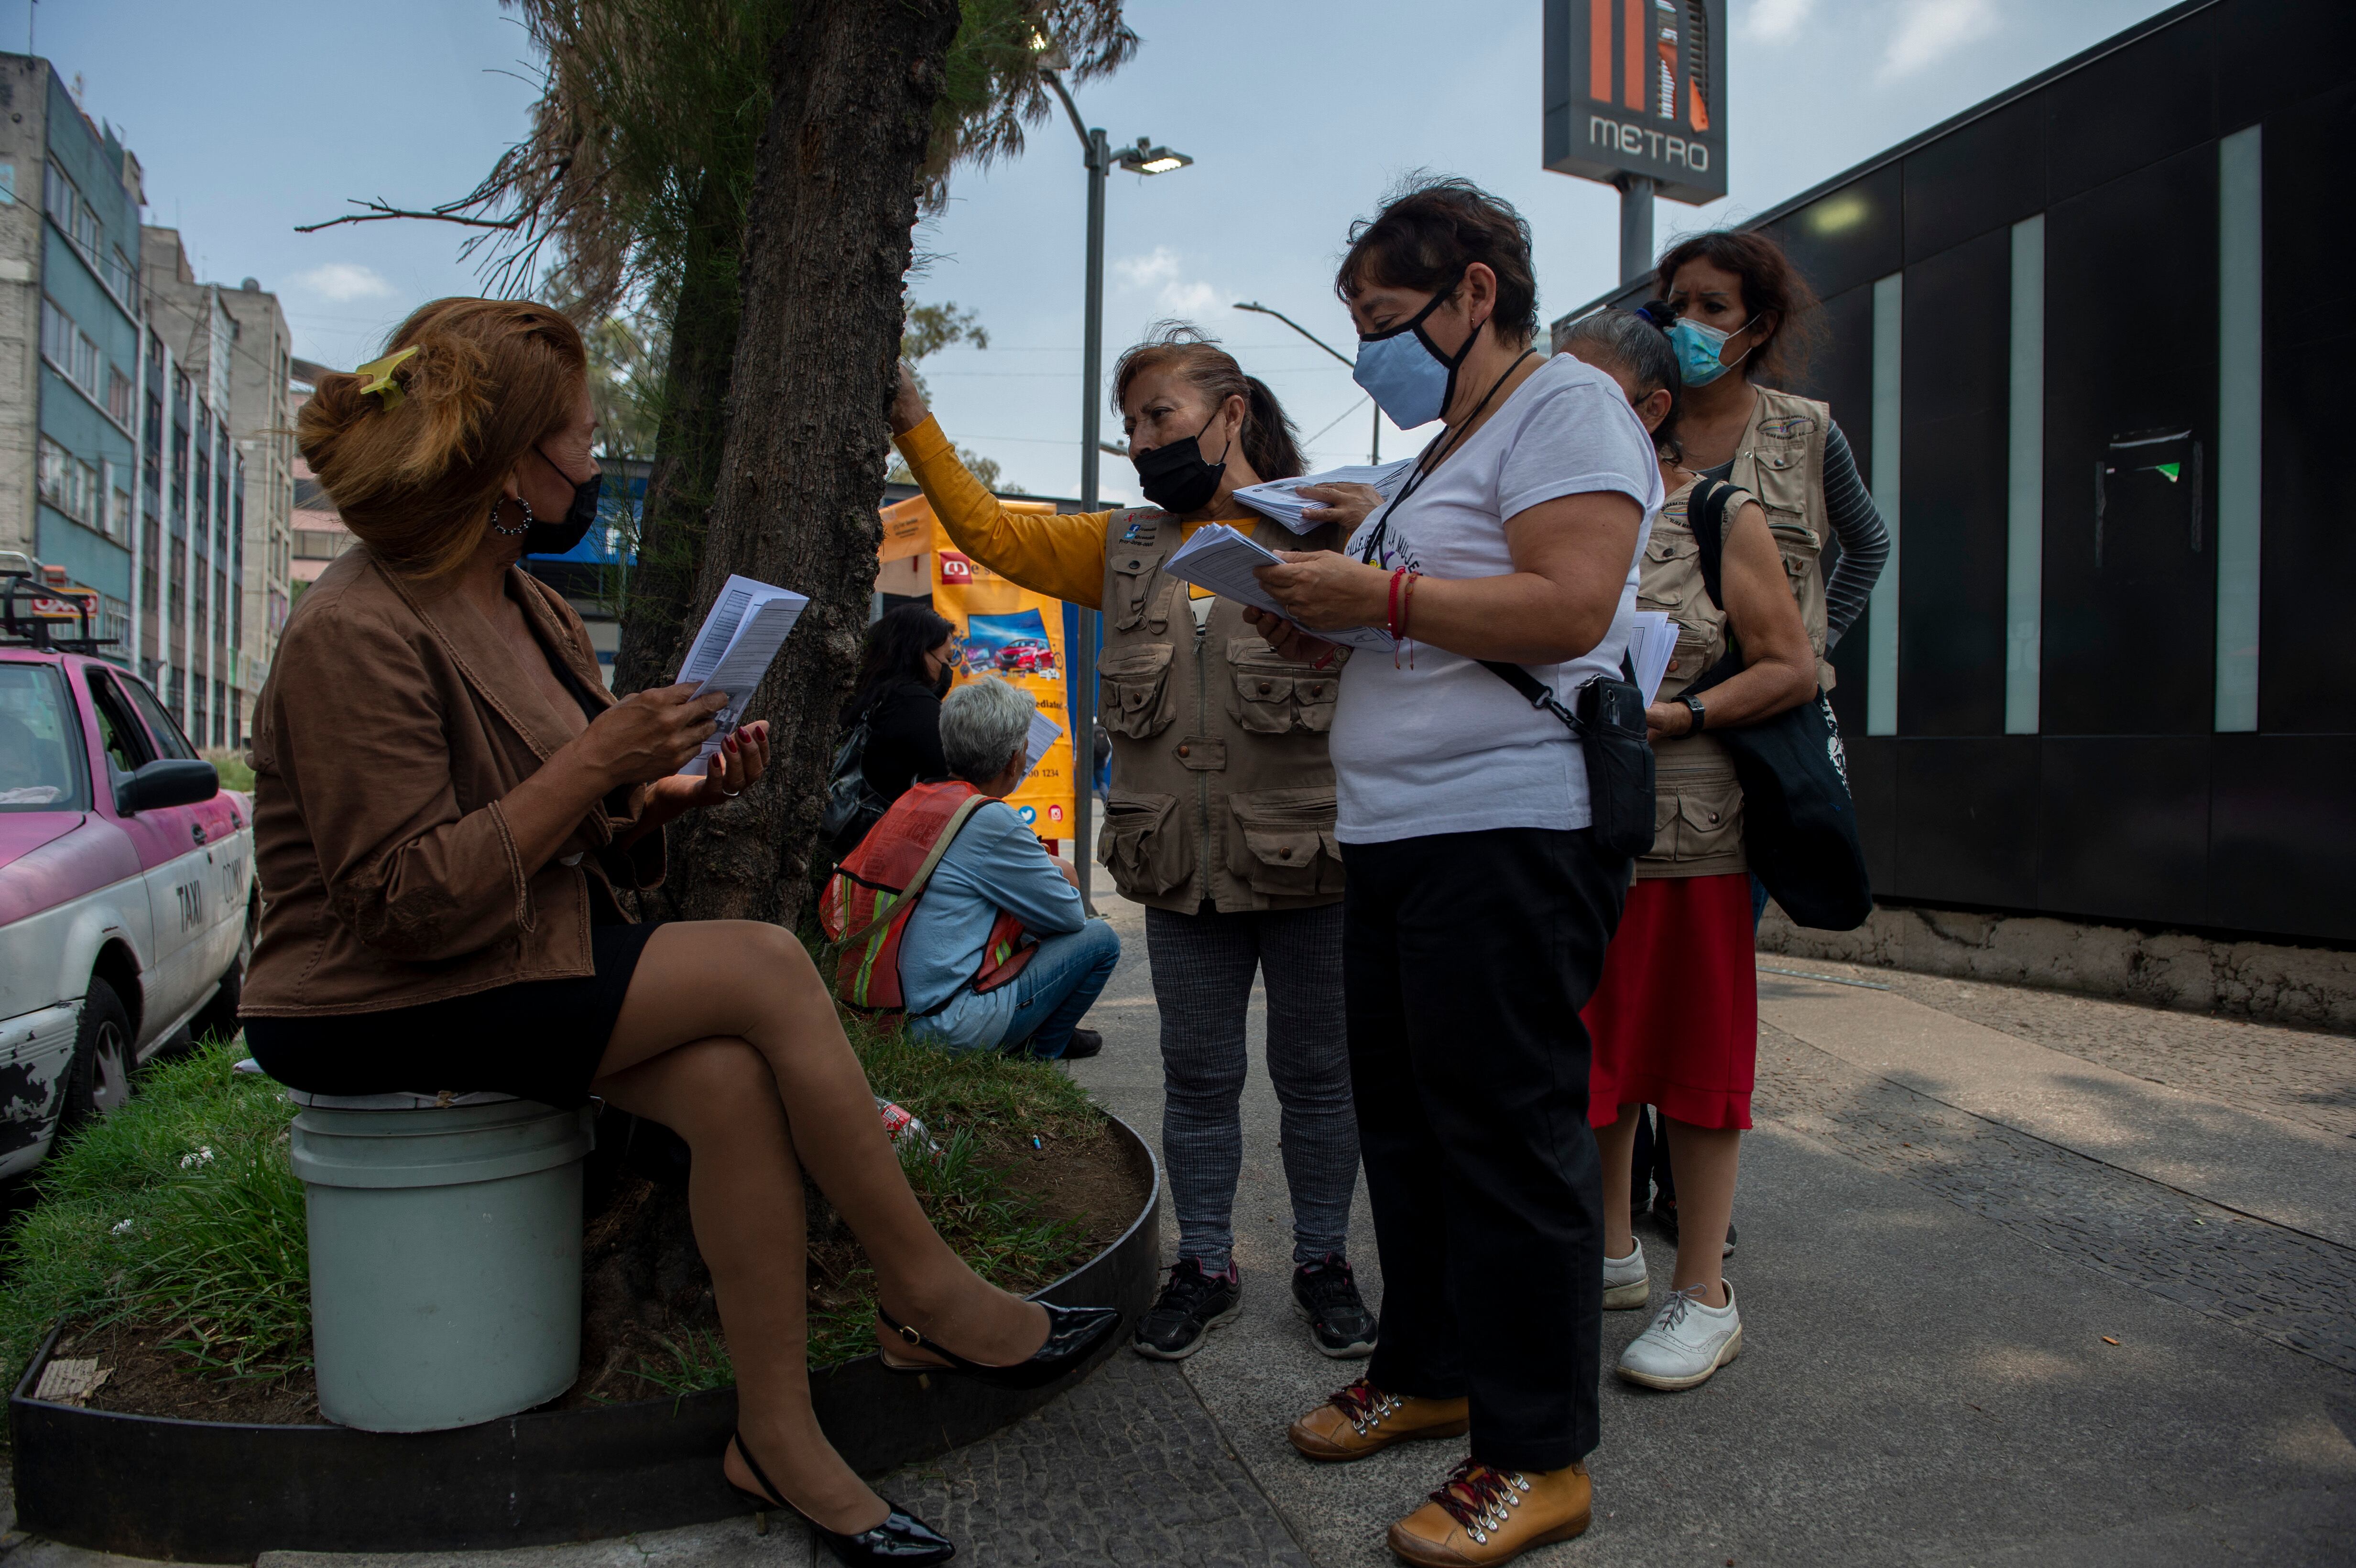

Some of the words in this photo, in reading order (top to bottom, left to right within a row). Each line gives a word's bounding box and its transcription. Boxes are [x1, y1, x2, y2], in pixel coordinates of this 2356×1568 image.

[1590, 115, 1709, 172] METRO
[1396, 534, 1423, 576] MUJE
[1042, 769, 1059, 777] 1234
[176, 879, 202, 933] TAXI
